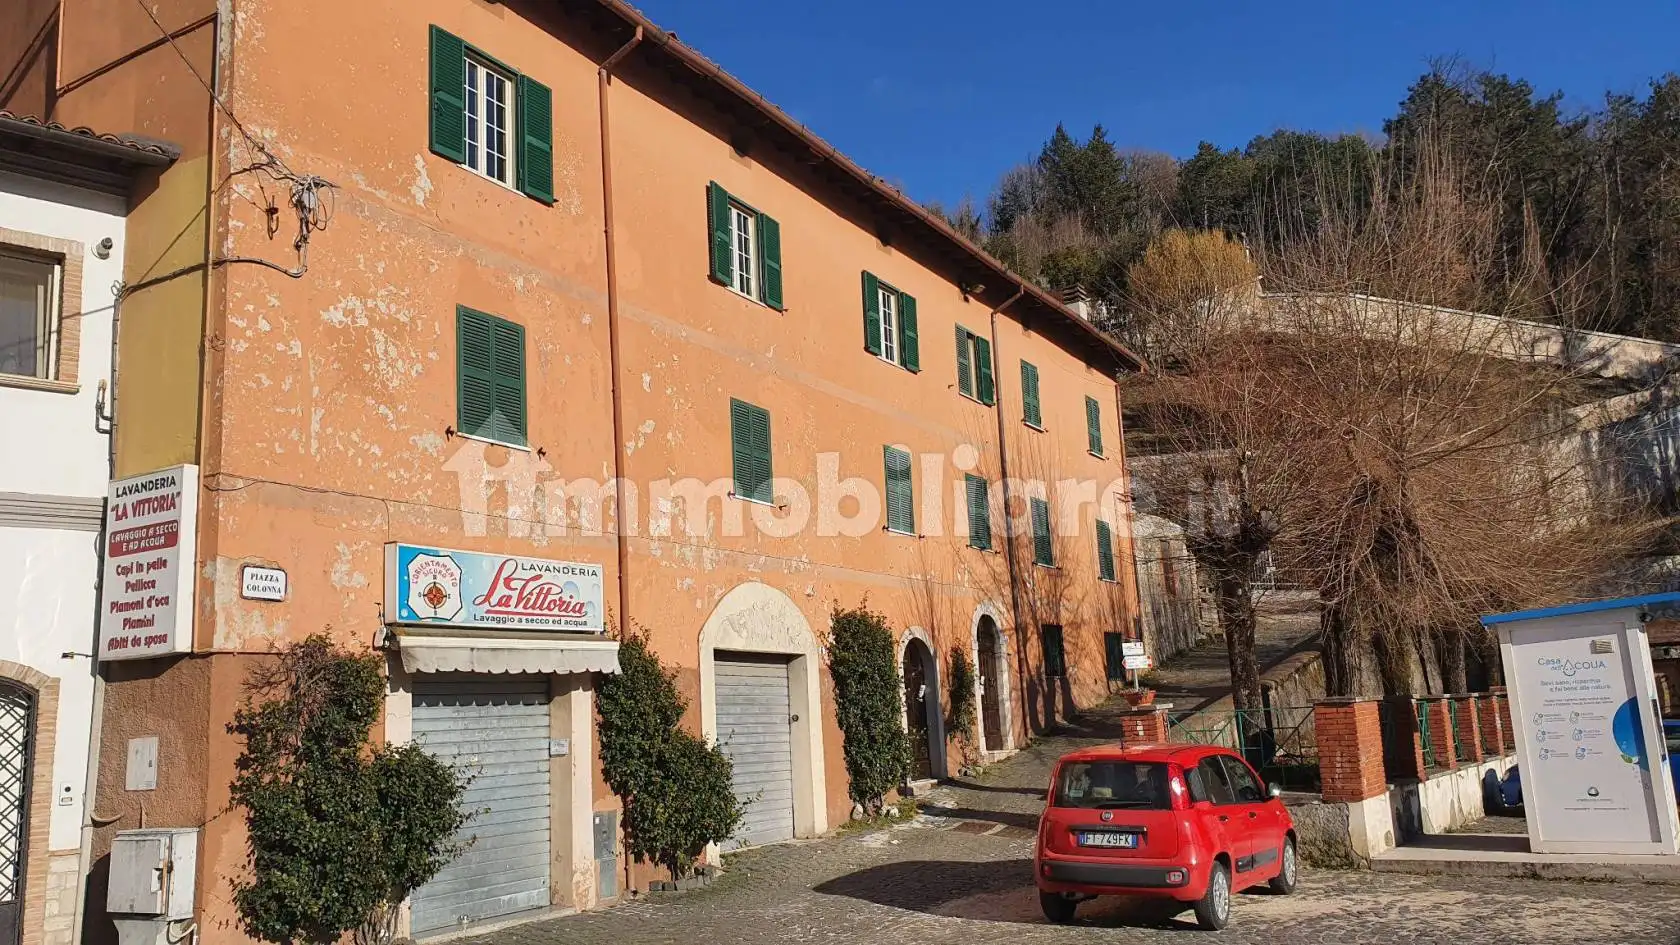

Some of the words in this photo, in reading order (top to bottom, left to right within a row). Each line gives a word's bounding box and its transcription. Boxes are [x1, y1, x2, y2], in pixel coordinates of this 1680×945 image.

[115, 475, 177, 498] LAVANDERIA
[111, 528, 147, 543] LAVAGGIO
[156, 523, 178, 535] SECCO
[116, 562, 134, 577] Capi
[136, 561, 144, 573] in
[422, 569, 447, 579] SICURO
[521, 562, 599, 577] LAVANDERIA
[250, 573, 279, 582] PIAZZA
[246, 584, 282, 593] COLONNA
[472, 558, 518, 608] La
[503, 574, 588, 615] Vittoria
[473, 613, 515, 624] Lavaggio
[525, 616, 550, 624] secco
[552, 617, 562, 625] ed
[564, 619, 588, 627] acqua
[108, 636, 128, 651] Abiti
[144, 633, 168, 648] sposa
[1538, 657, 1561, 666] Casa
